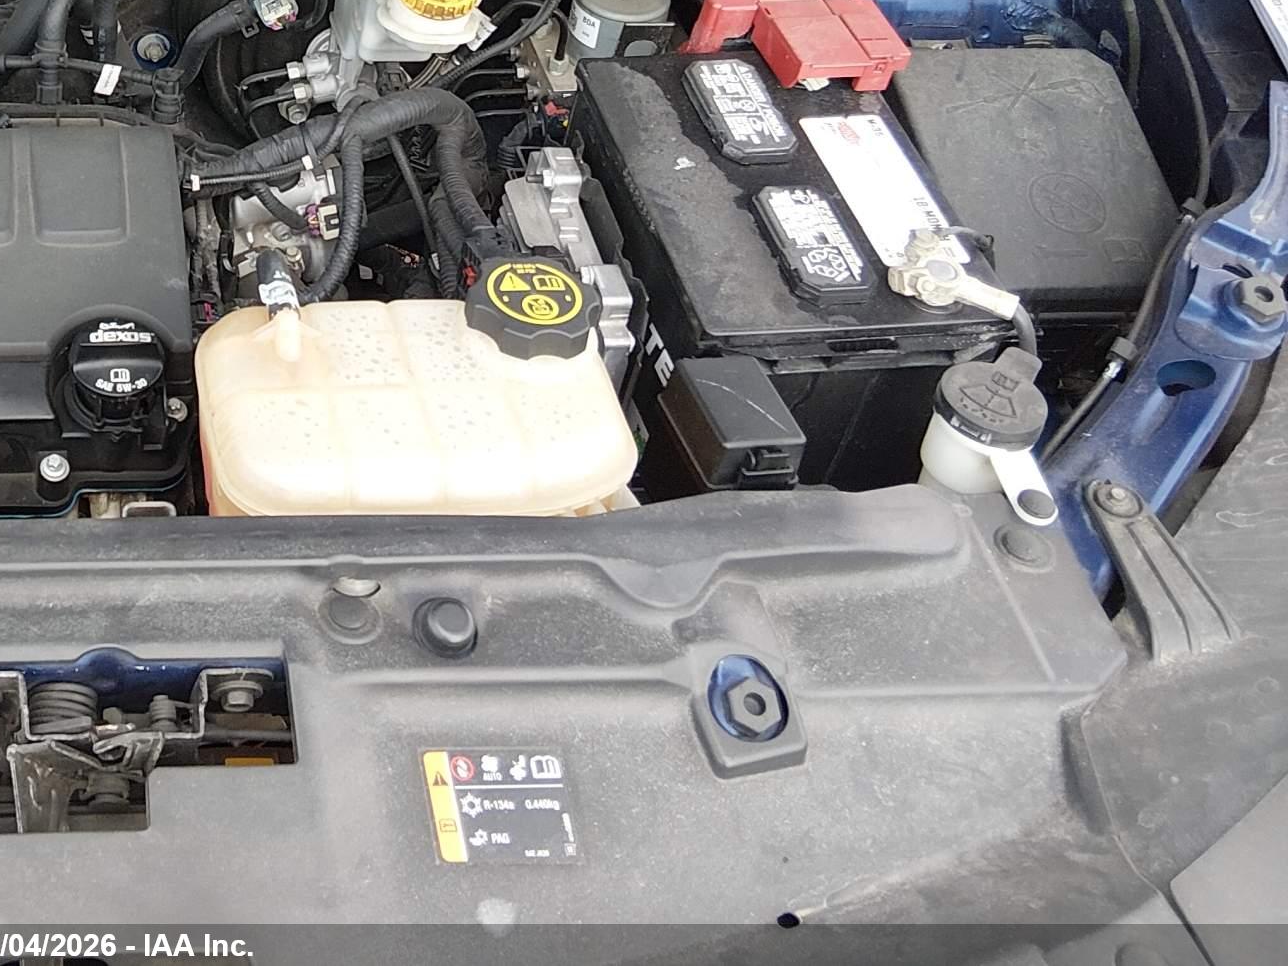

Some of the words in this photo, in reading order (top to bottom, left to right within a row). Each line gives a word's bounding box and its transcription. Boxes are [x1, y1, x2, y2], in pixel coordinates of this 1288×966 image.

[924, 210, 951, 241] MONH
[89, 328, 152, 343] dexos
[95, 378, 114, 392] SAE
[116, 378, 148, 393] 5W-30
[482, 799, 516, 810] R-134a
